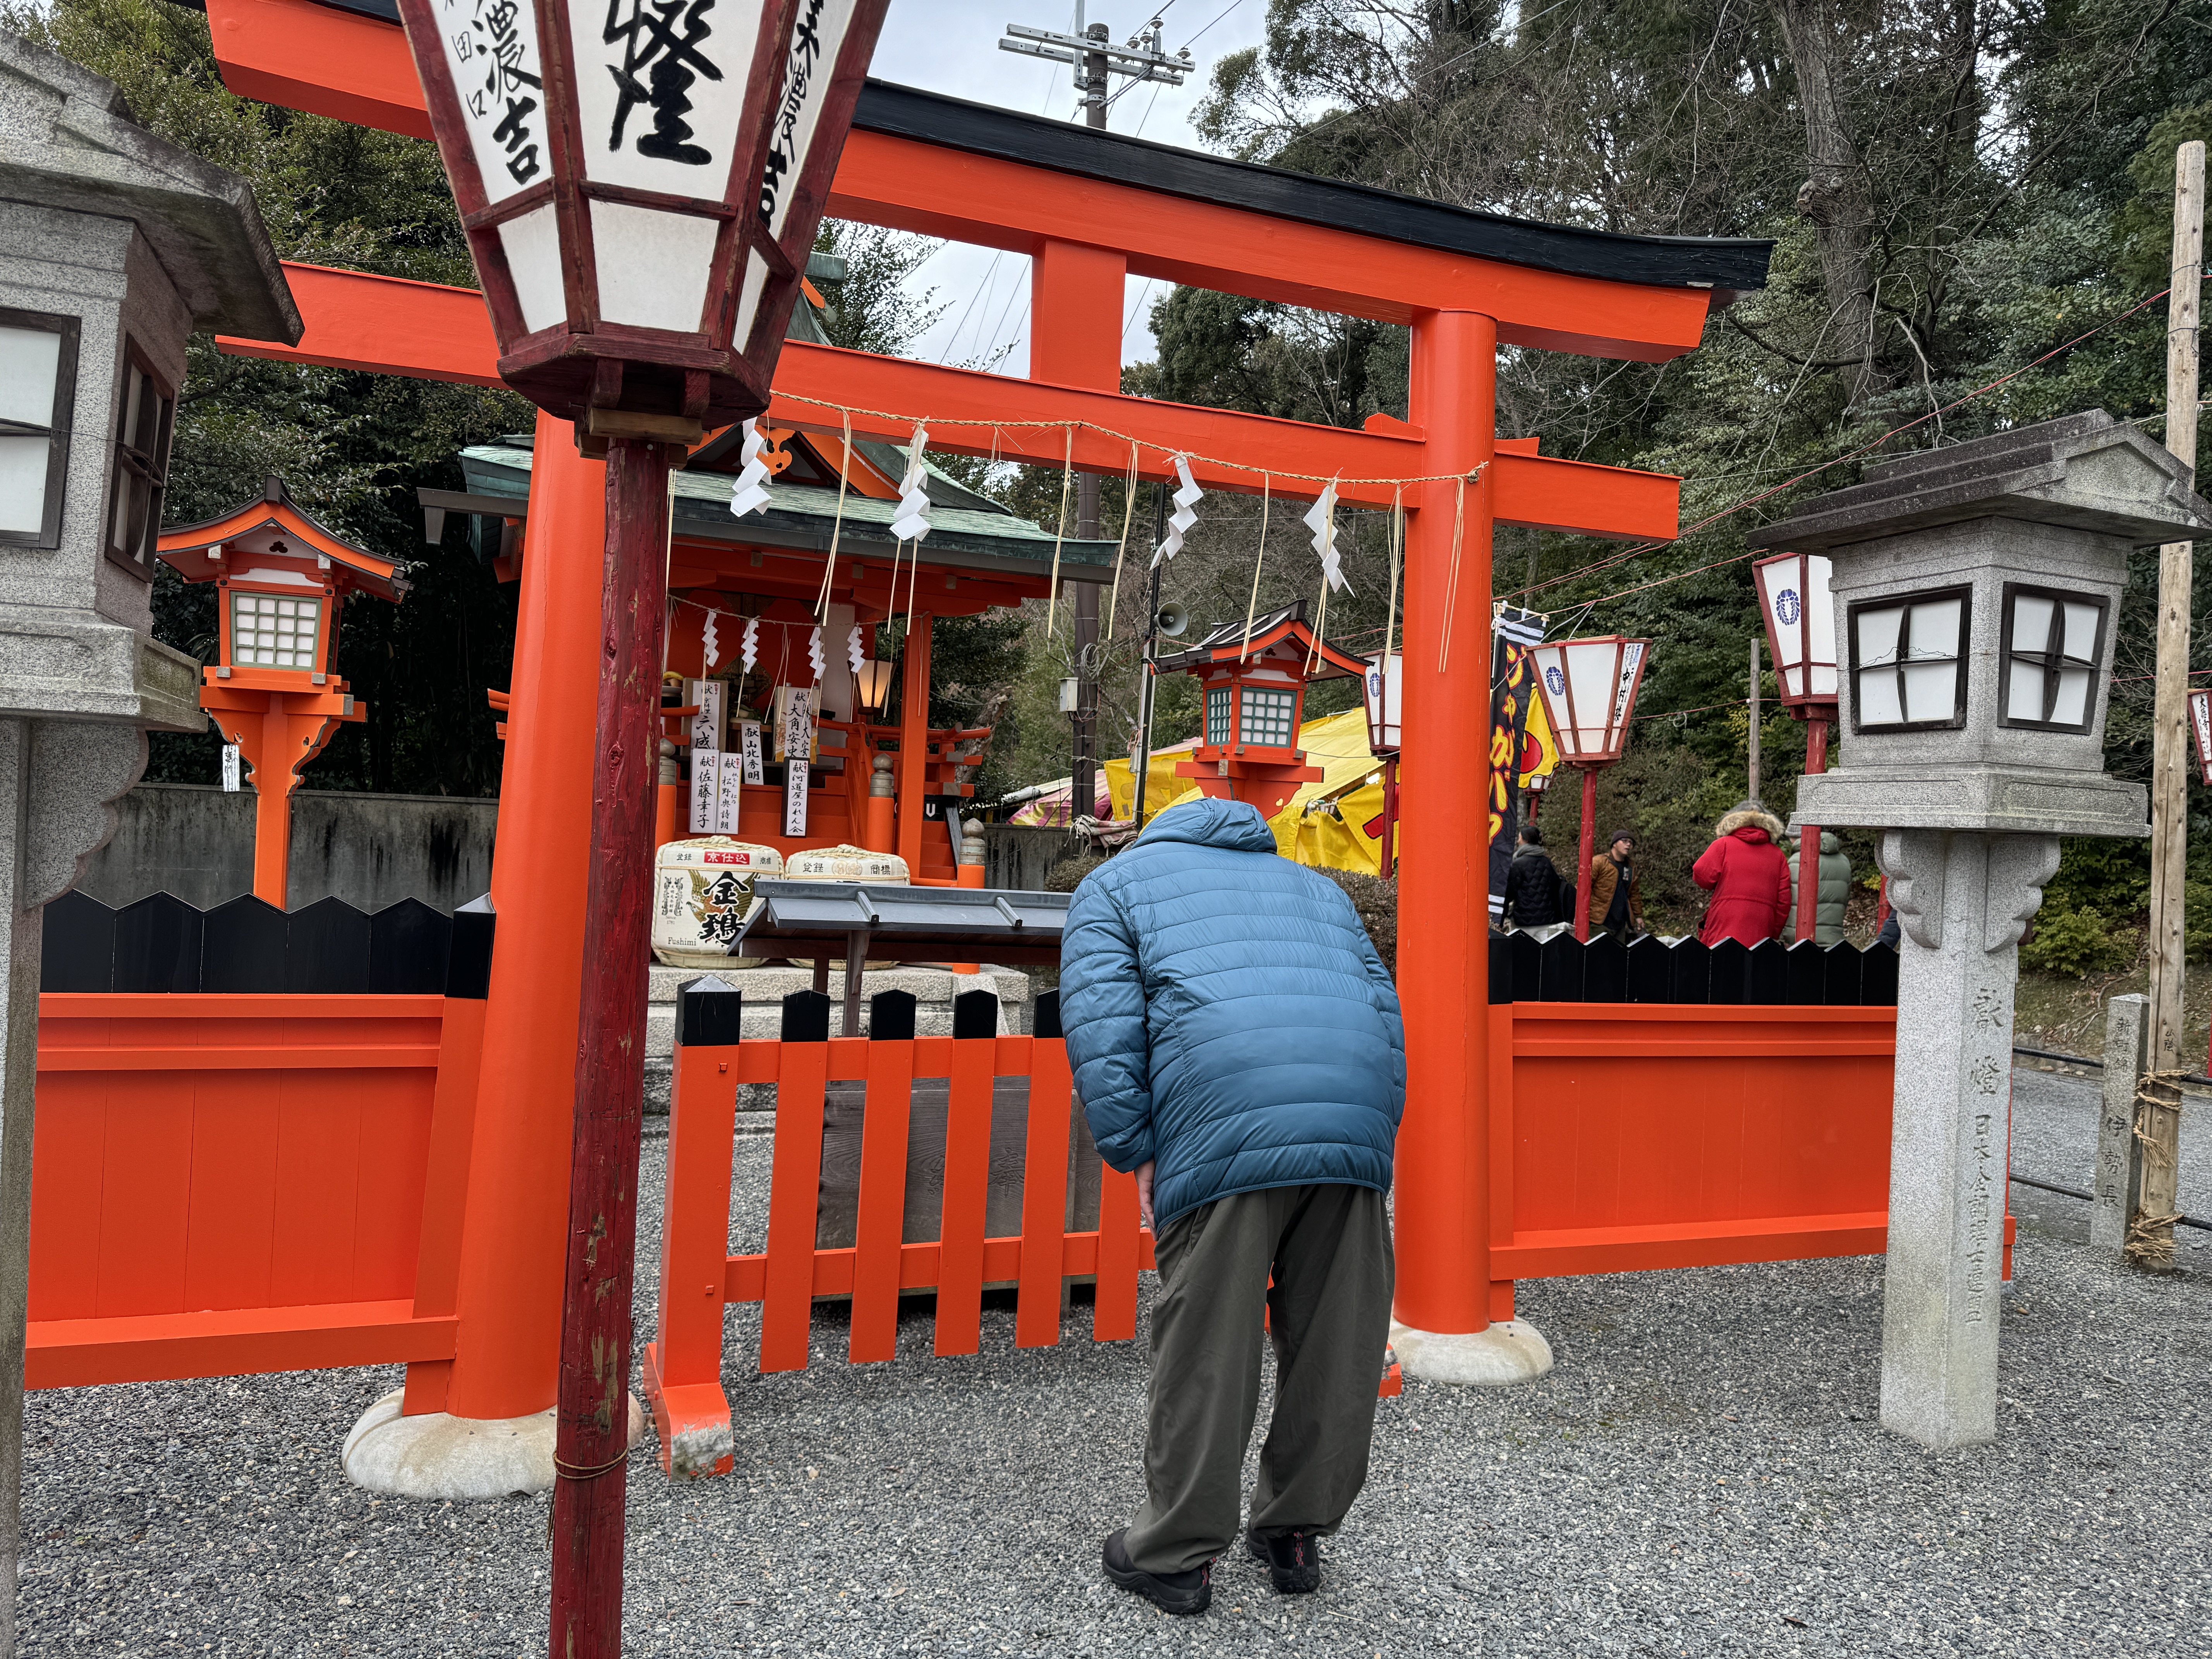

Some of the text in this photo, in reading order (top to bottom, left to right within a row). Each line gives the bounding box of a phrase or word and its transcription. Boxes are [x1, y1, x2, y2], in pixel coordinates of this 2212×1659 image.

[445, 0, 487, 120] 田口
[471, 0, 543, 185] 濃吉
[707, 853, 748, 864] 京仕込
[803, 862, 824, 872] 登録
[871, 864, 891, 875] 商標
[668, 937, 696, 946] Fushimi
